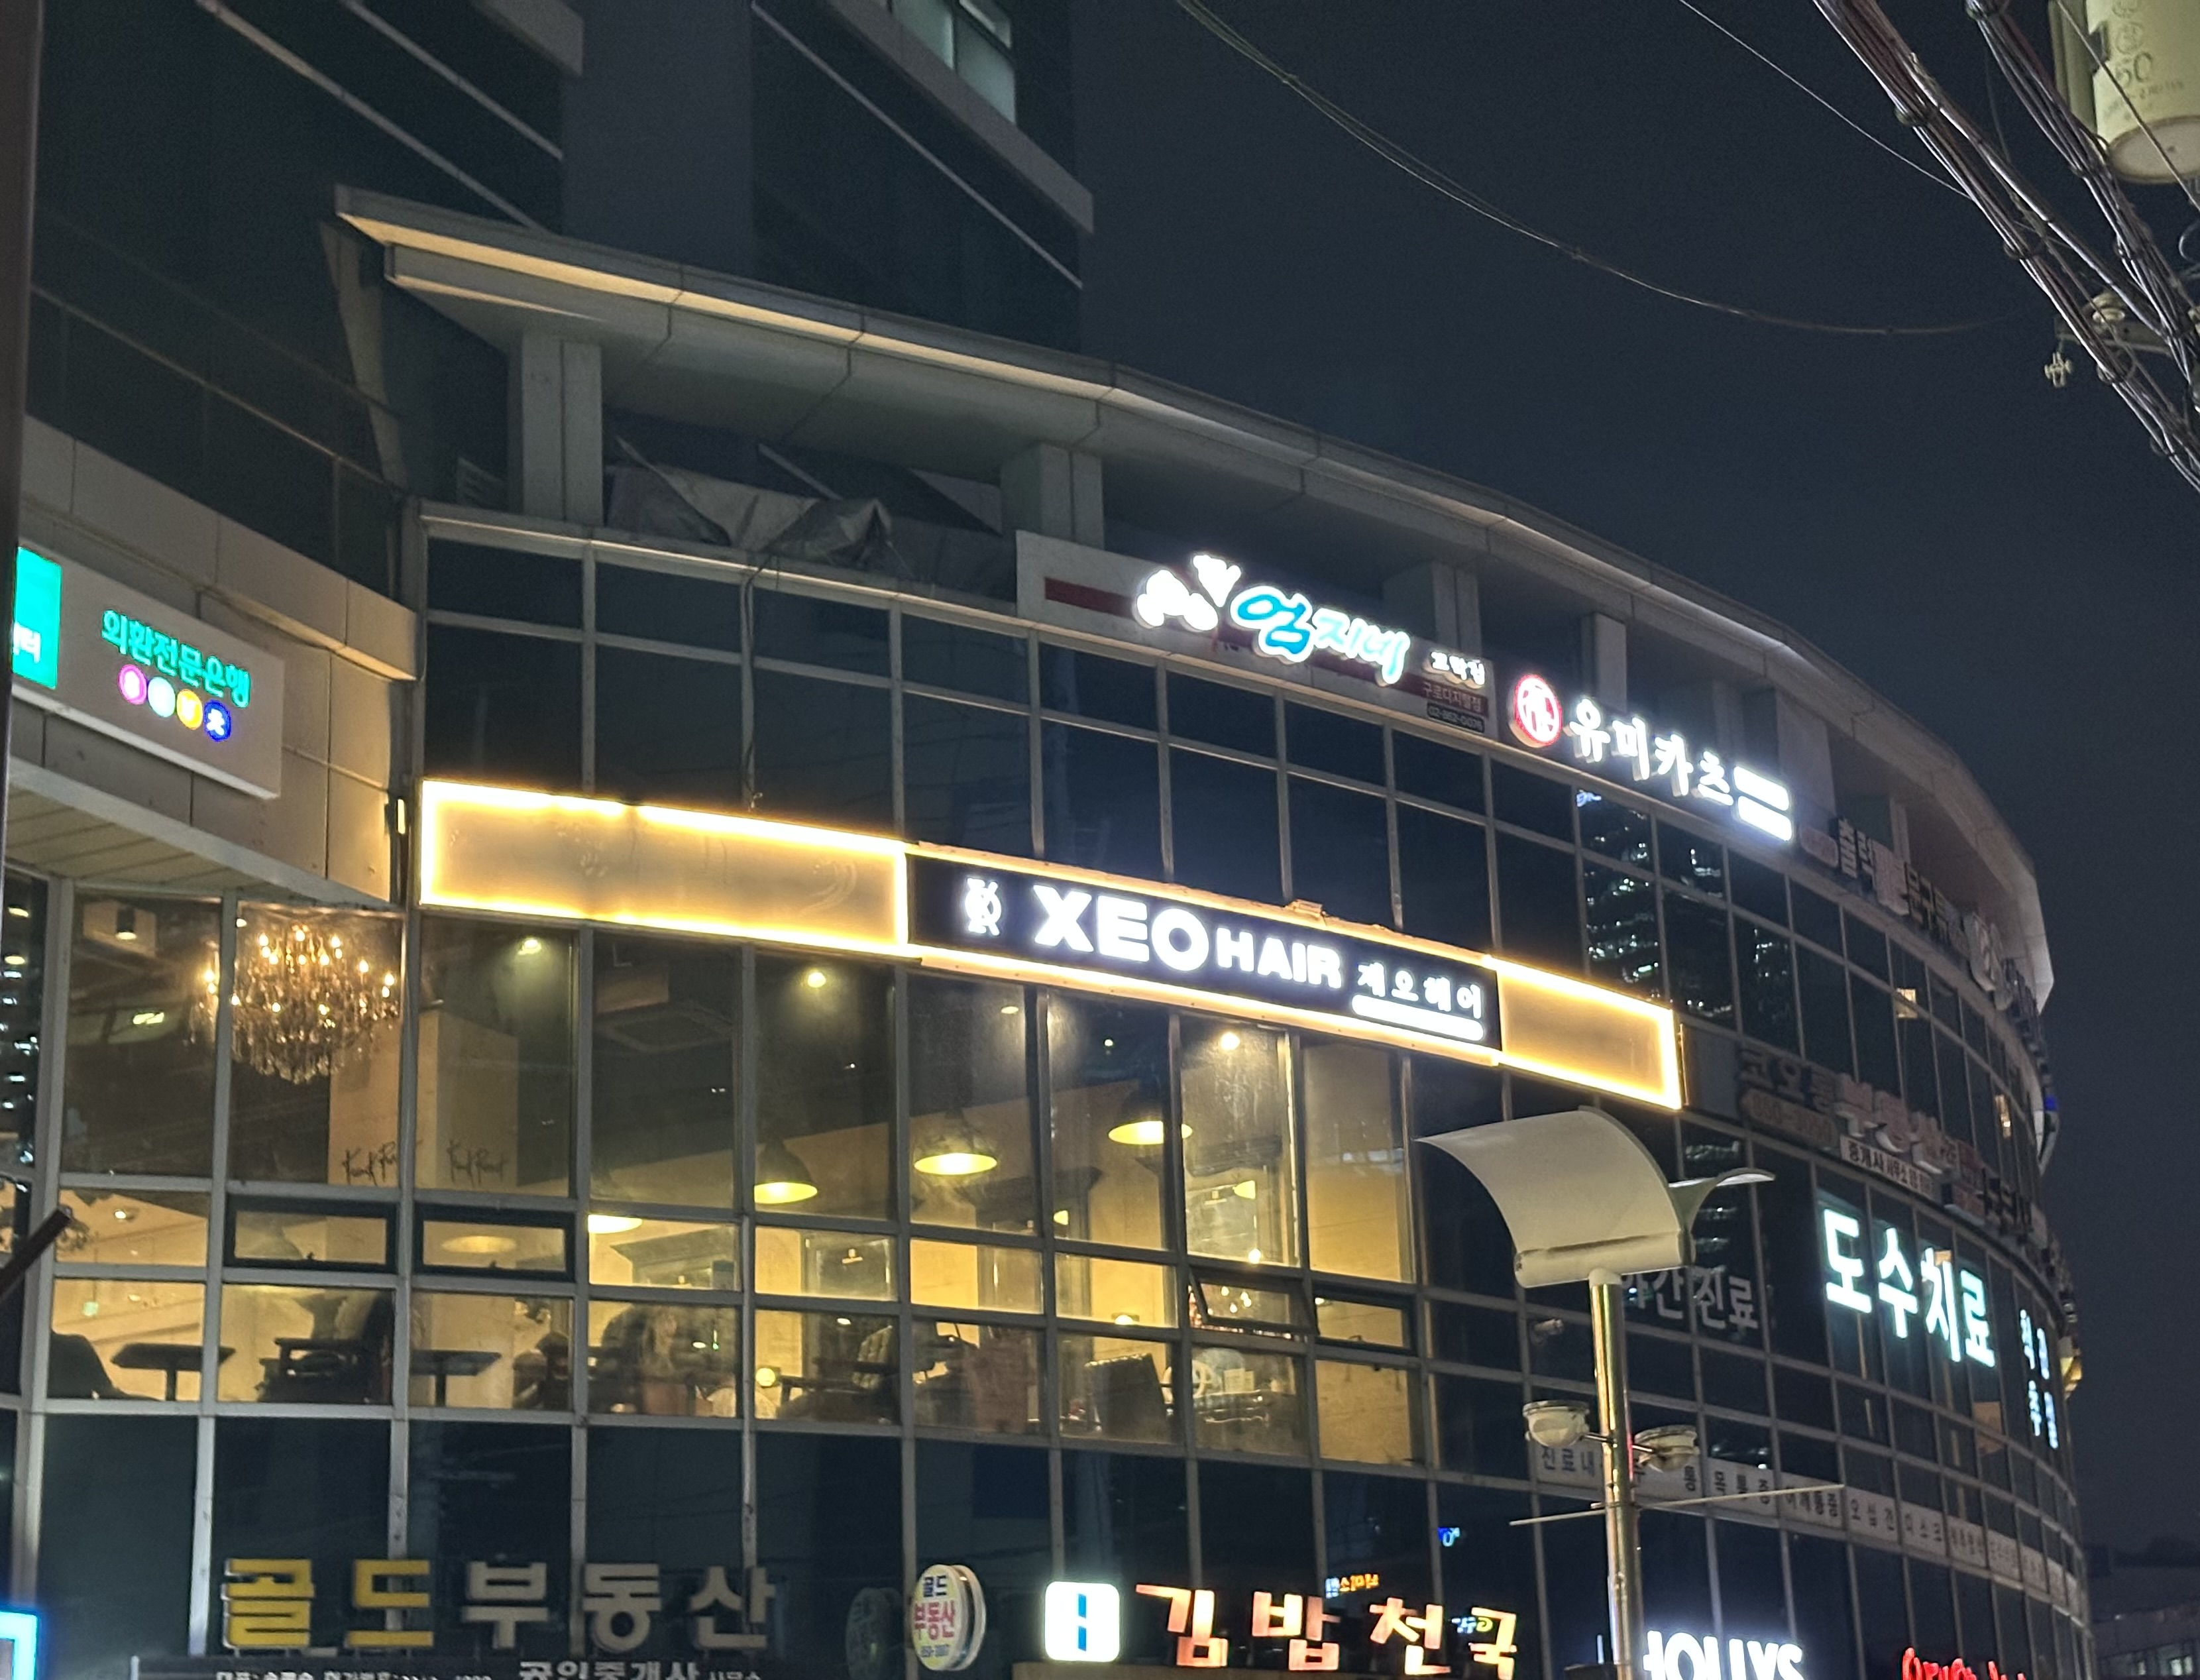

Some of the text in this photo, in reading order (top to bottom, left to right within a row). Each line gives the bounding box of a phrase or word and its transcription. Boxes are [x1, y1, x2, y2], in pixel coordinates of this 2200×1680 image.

[101, 608, 251, 709] 외환전문은행
[1231, 586, 1410, 684] 엄지네
[1568, 698, 1734, 806] 유미카츠
[1032, 884, 1343, 989] XEO HAIR
[1824, 1208, 1996, 1368] 도수치료
[222, 1559, 775, 1650] 골드부동산
[914, 1599, 956, 1641] 부동산
[923, 1575, 948, 1598] 골드
[1135, 1583, 1517, 1680] 김밥천국
